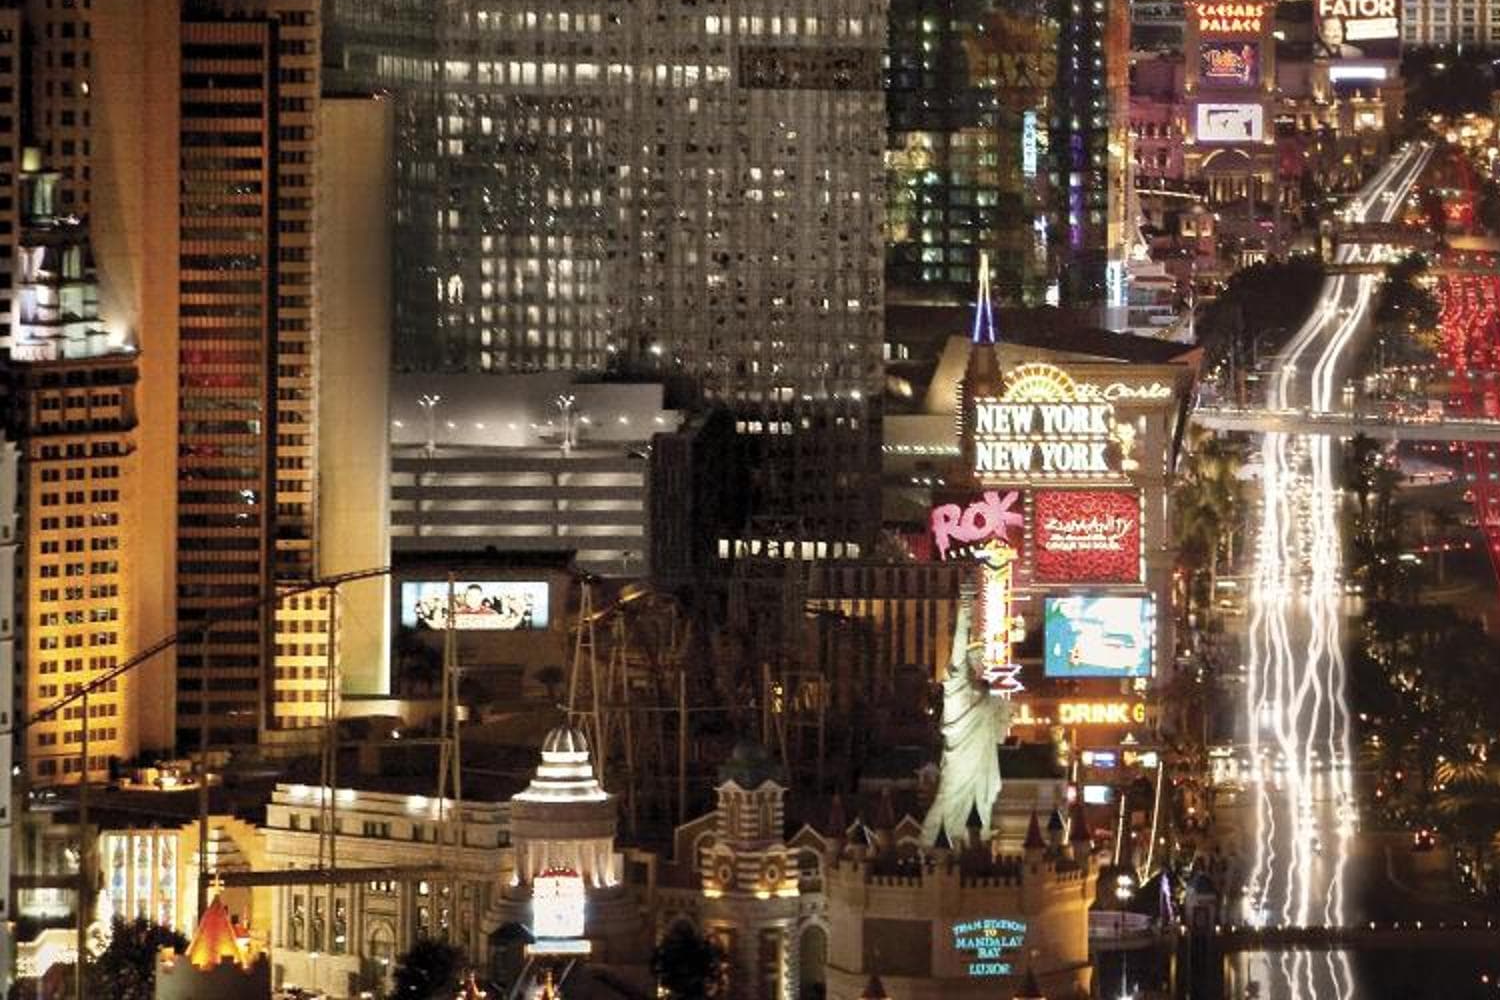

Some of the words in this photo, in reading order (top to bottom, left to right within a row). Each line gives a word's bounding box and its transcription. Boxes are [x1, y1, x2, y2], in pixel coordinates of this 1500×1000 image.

[1197, 3, 1264, 17] CAESARS
[1199, 18, 1262, 32] PALACE
[975, 404, 1036, 434] NEW
[1040, 404, 1109, 434] YORK
[975, 442, 1036, 472] NEW
[1040, 442, 1109, 472] YORK
[931, 490, 1025, 562] ROK
[1058, 702, 1130, 724] DRINK
[983, 929, 998, 937] TO
[955, 936, 1024, 949] MANDALAY
[977, 947, 1001, 959] BAY
[969, 963, 1010, 976] LUXOR
